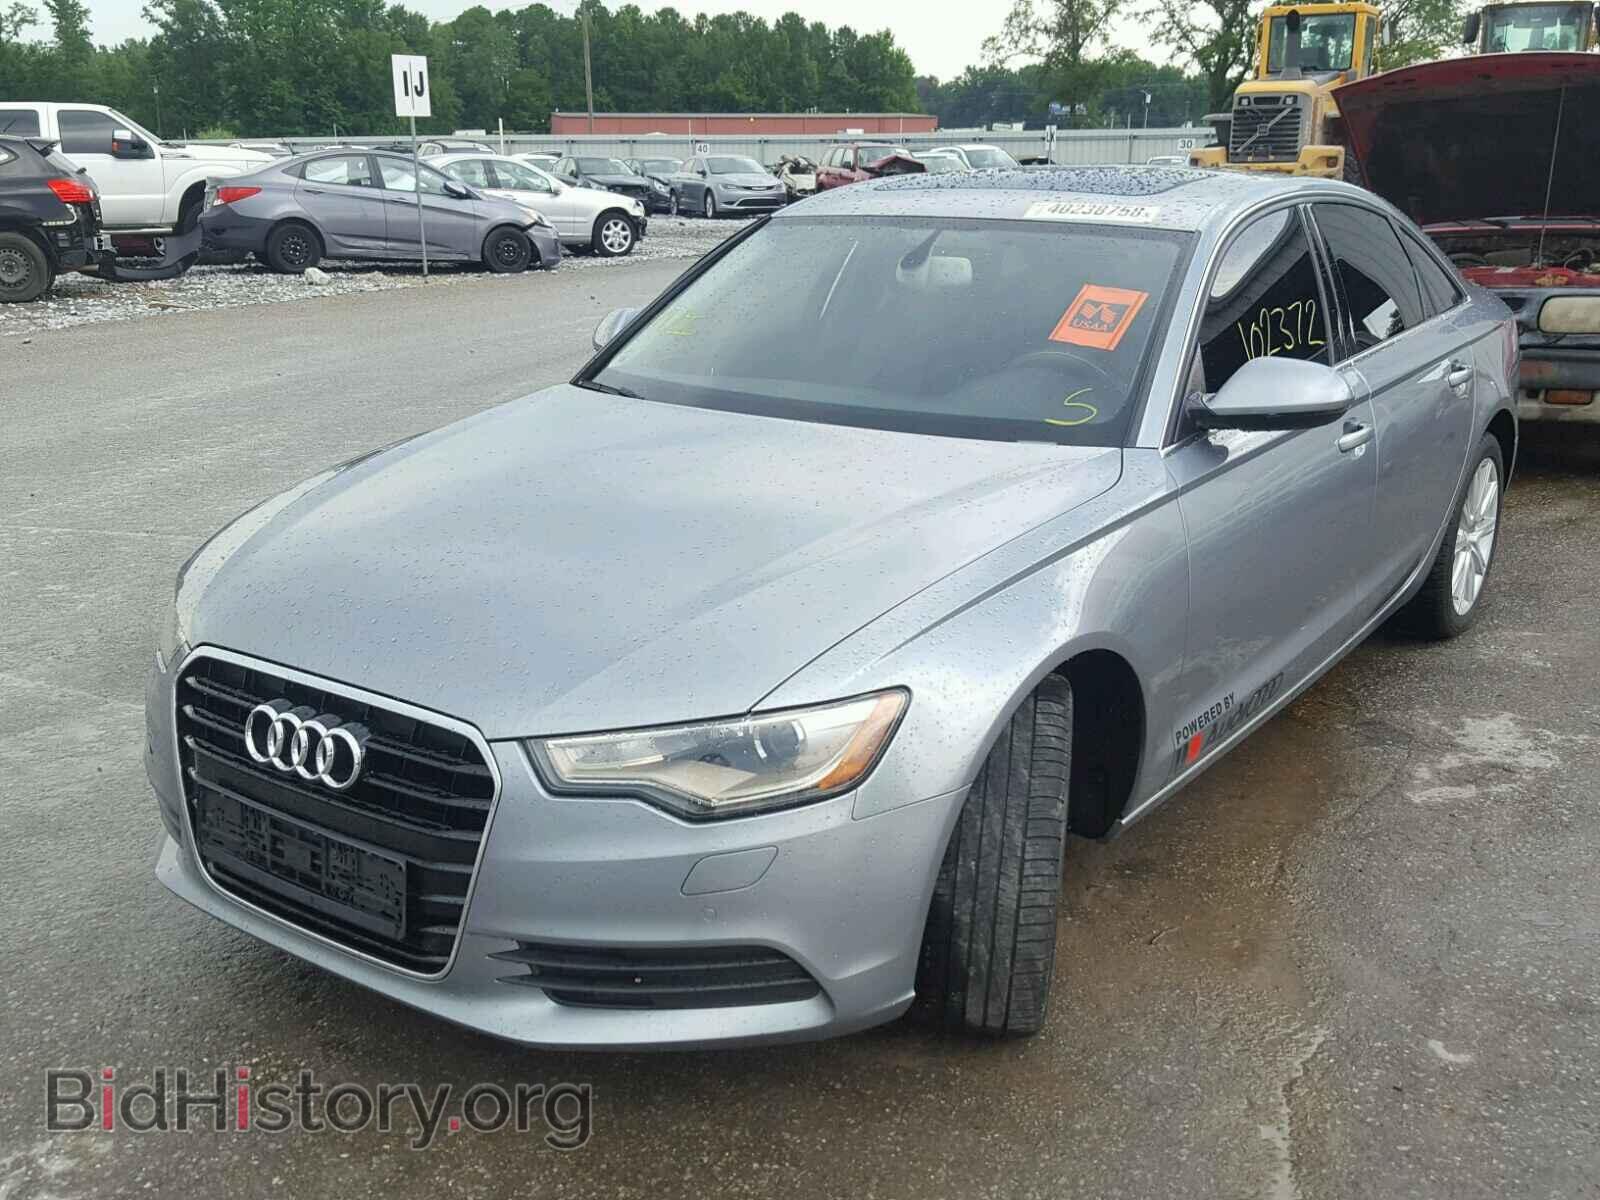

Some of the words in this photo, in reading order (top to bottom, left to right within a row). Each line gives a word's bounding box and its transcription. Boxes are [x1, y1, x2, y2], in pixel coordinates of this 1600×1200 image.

[1179, 139, 1193, 149] 30
[1175, 702, 1222, 746] POWERED
[1223, 691, 1236, 711] BY
